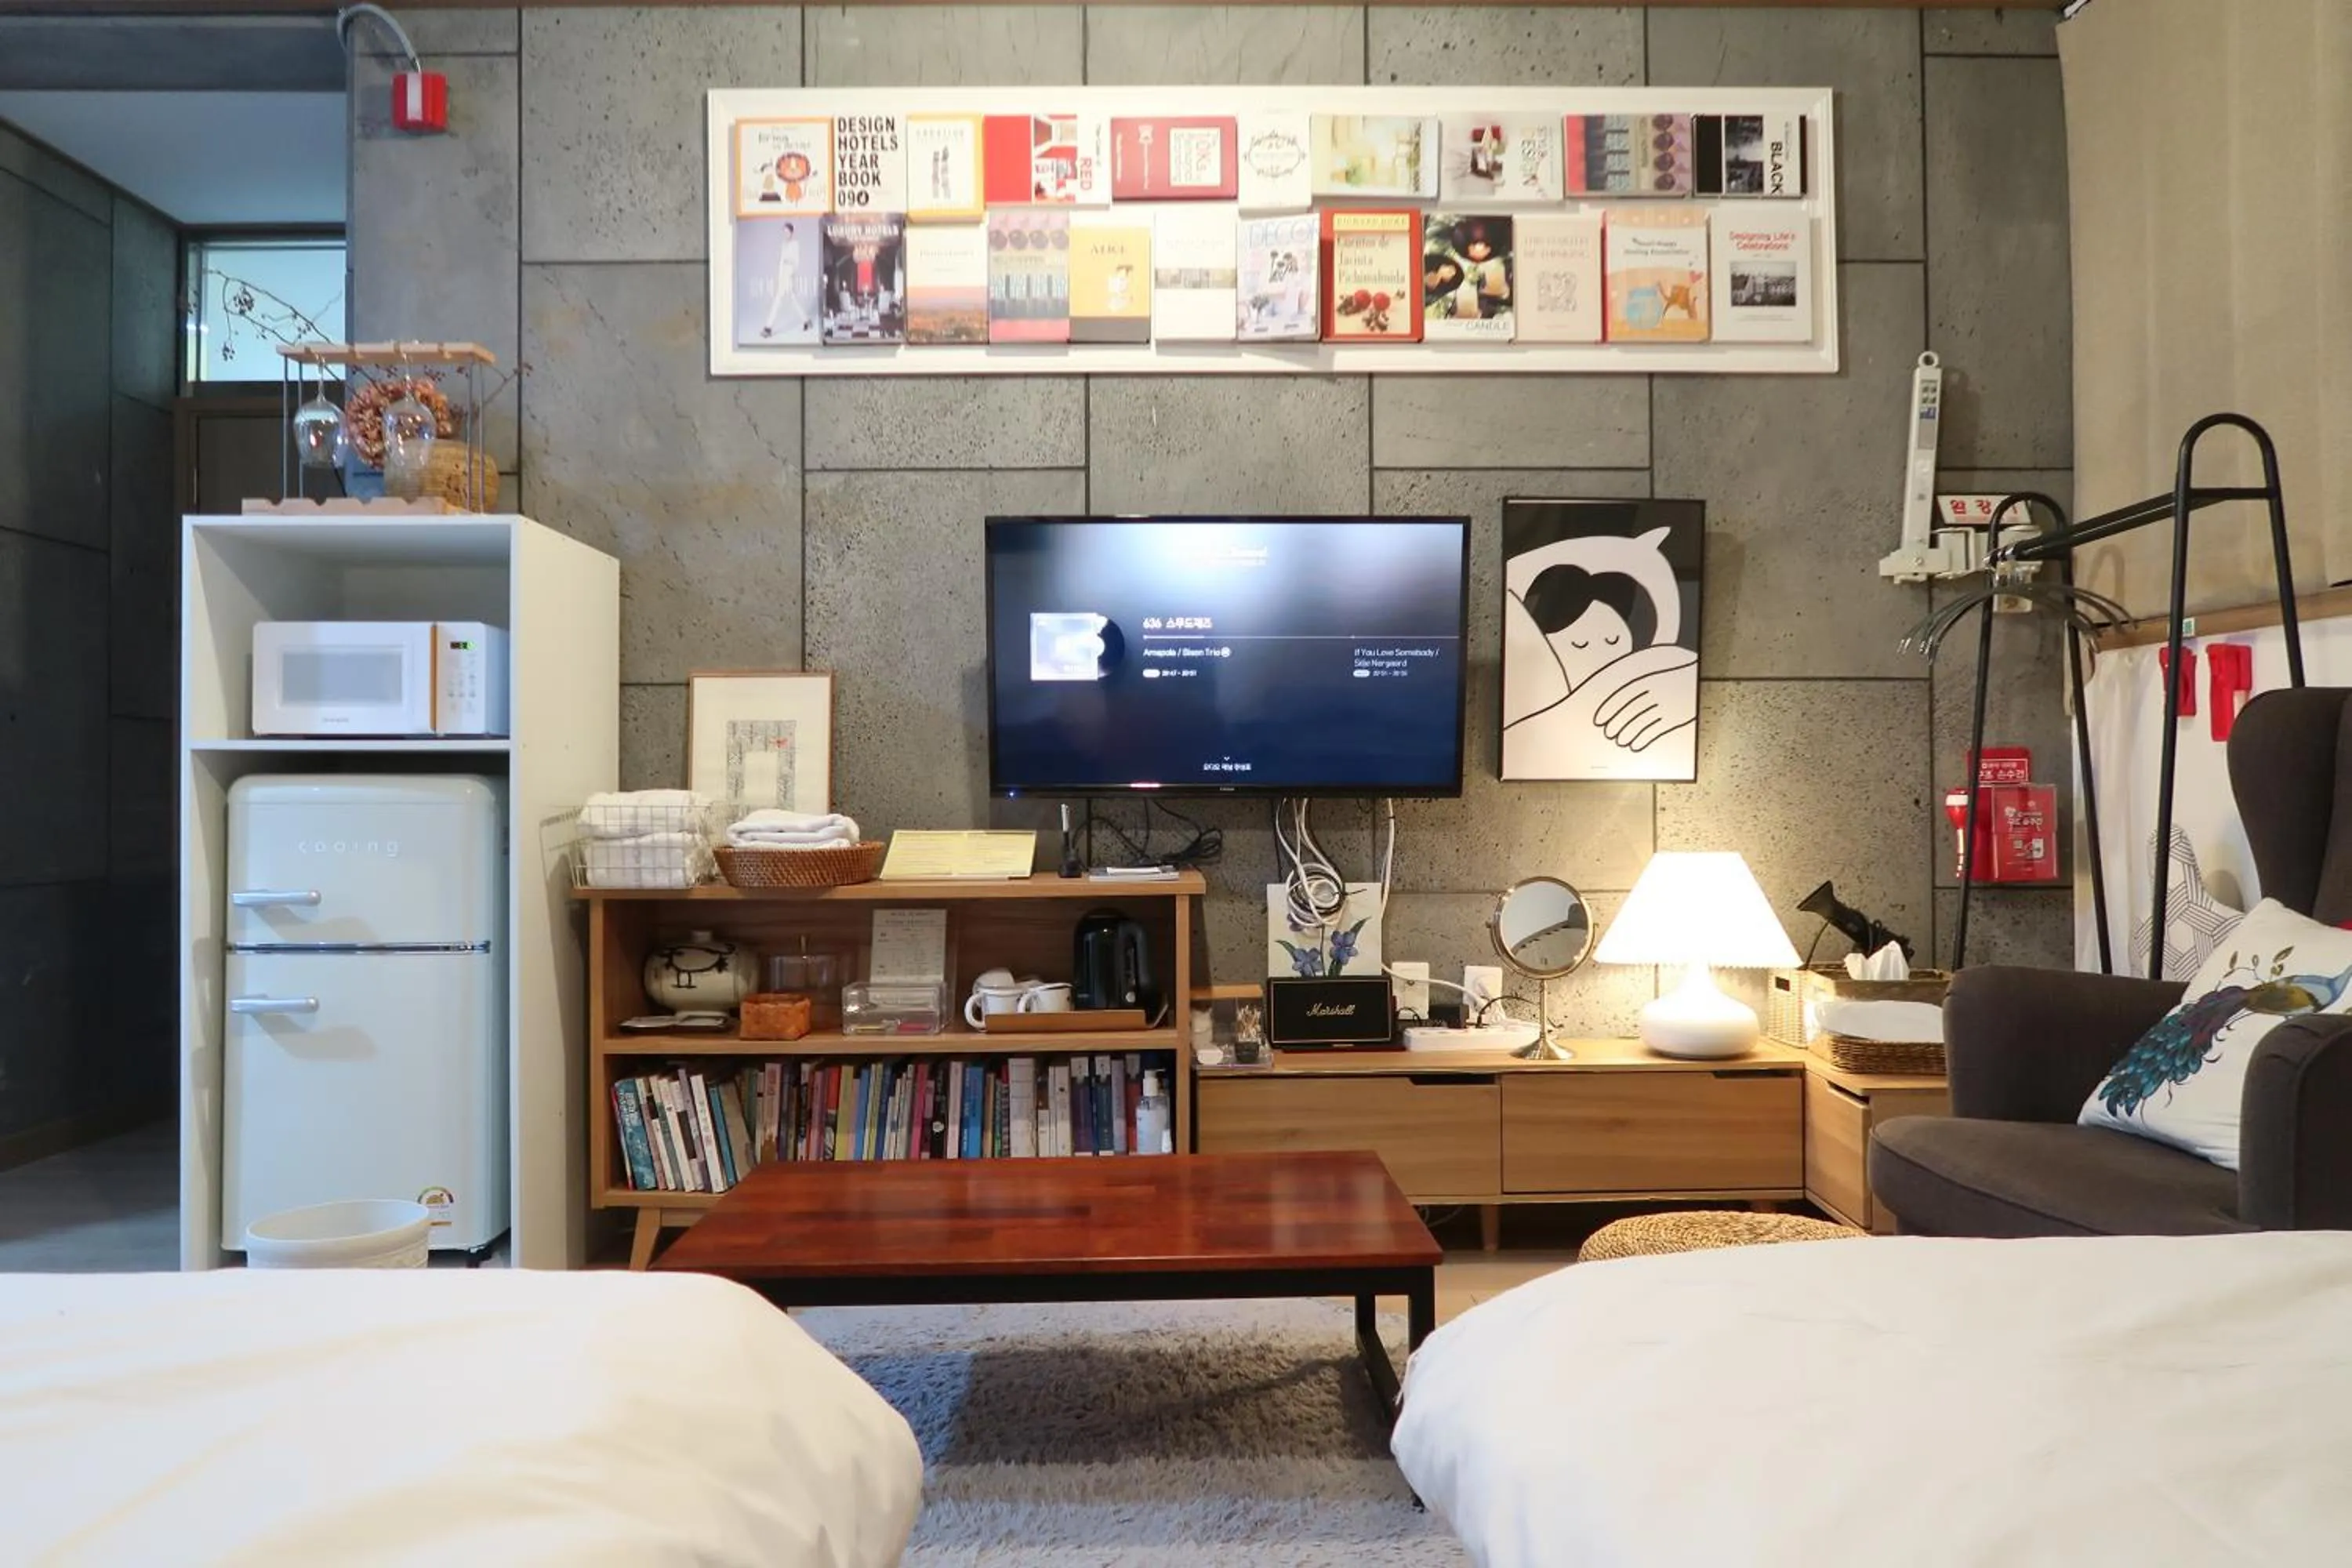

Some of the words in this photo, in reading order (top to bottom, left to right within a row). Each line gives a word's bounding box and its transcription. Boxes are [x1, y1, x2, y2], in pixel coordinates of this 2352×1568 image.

[838, 116, 895, 132] DESIGN
[838, 134, 898, 151] HOTELS
[838, 154, 879, 169] YEAR
[1769, 141, 1784, 196] BLACK
[838, 170, 881, 187] BOOK
[1080, 158, 1093, 191] RED
[1377, 648, 1394, 657] Love
[1305, 1003, 1356, 1017] Marshall
